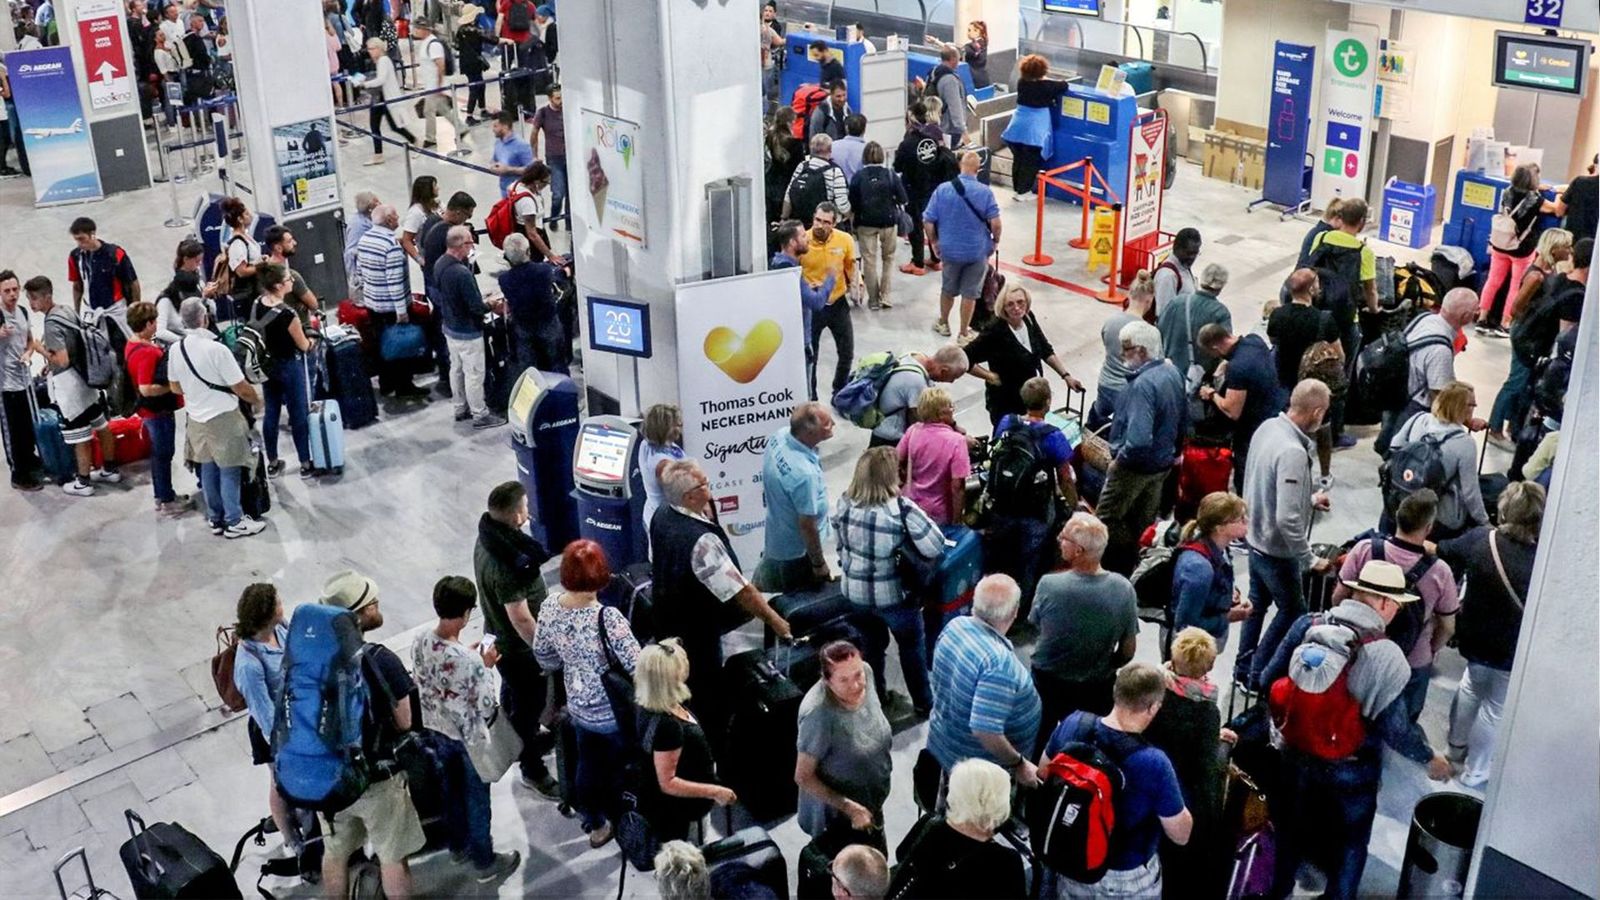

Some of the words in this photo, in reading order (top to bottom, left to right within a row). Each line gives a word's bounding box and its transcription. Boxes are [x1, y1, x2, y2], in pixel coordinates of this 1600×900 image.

[1529, 0, 1561, 19] 32
[1328, 108, 1363, 121] Welcome
[606, 310, 632, 337] 20
[699, 396, 755, 415] Thomas
[758, 387, 794, 405] Cook
[552, 417, 576, 428] AEGEAN
[701, 406, 795, 432] NECKERMANN
[703, 435, 769, 463] Signatu
[752, 472, 763, 483] ai
[597, 521, 622, 531] AEGEAN
